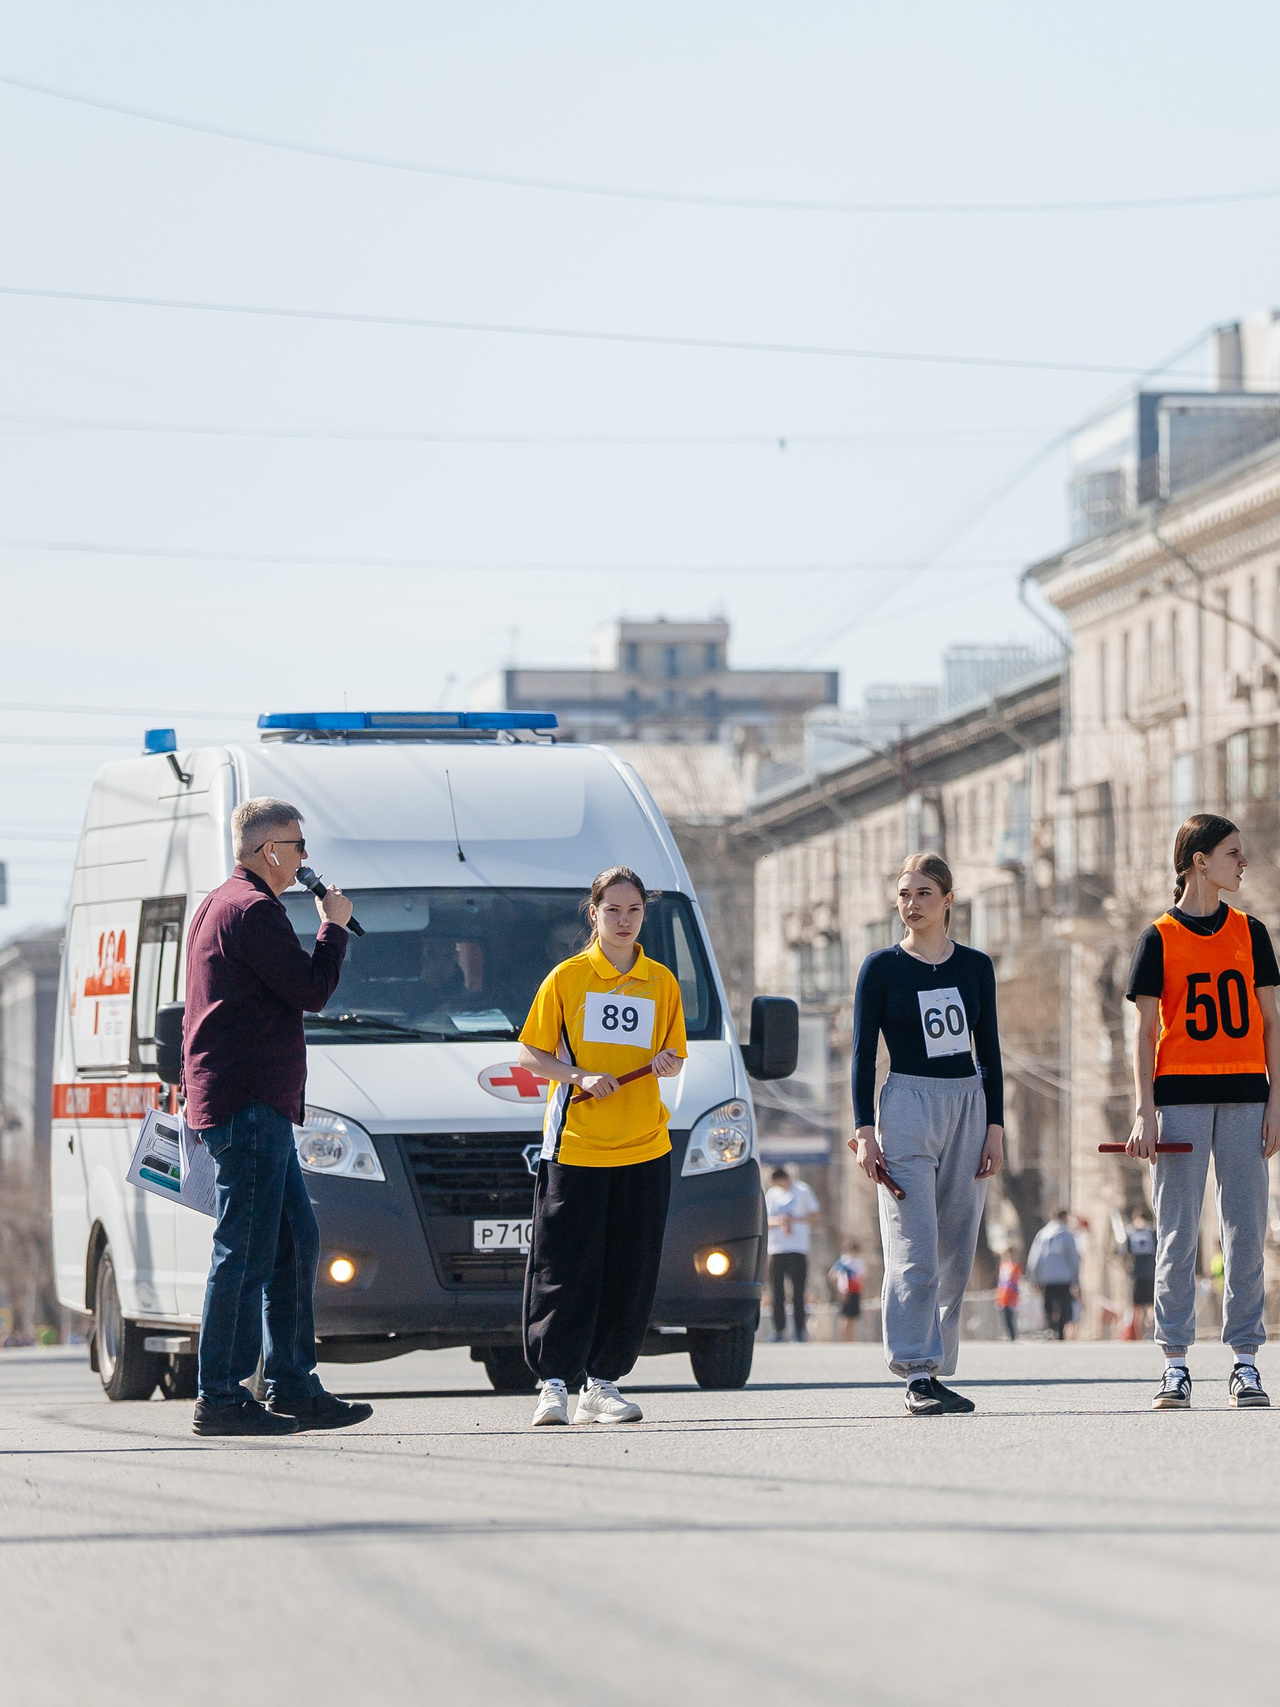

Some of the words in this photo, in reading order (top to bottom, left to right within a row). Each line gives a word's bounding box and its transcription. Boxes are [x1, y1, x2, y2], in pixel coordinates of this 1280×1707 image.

[601, 1004, 639, 1032] 89
[924, 1004, 965, 1039] 60
[1185, 969, 1250, 1041] 50
